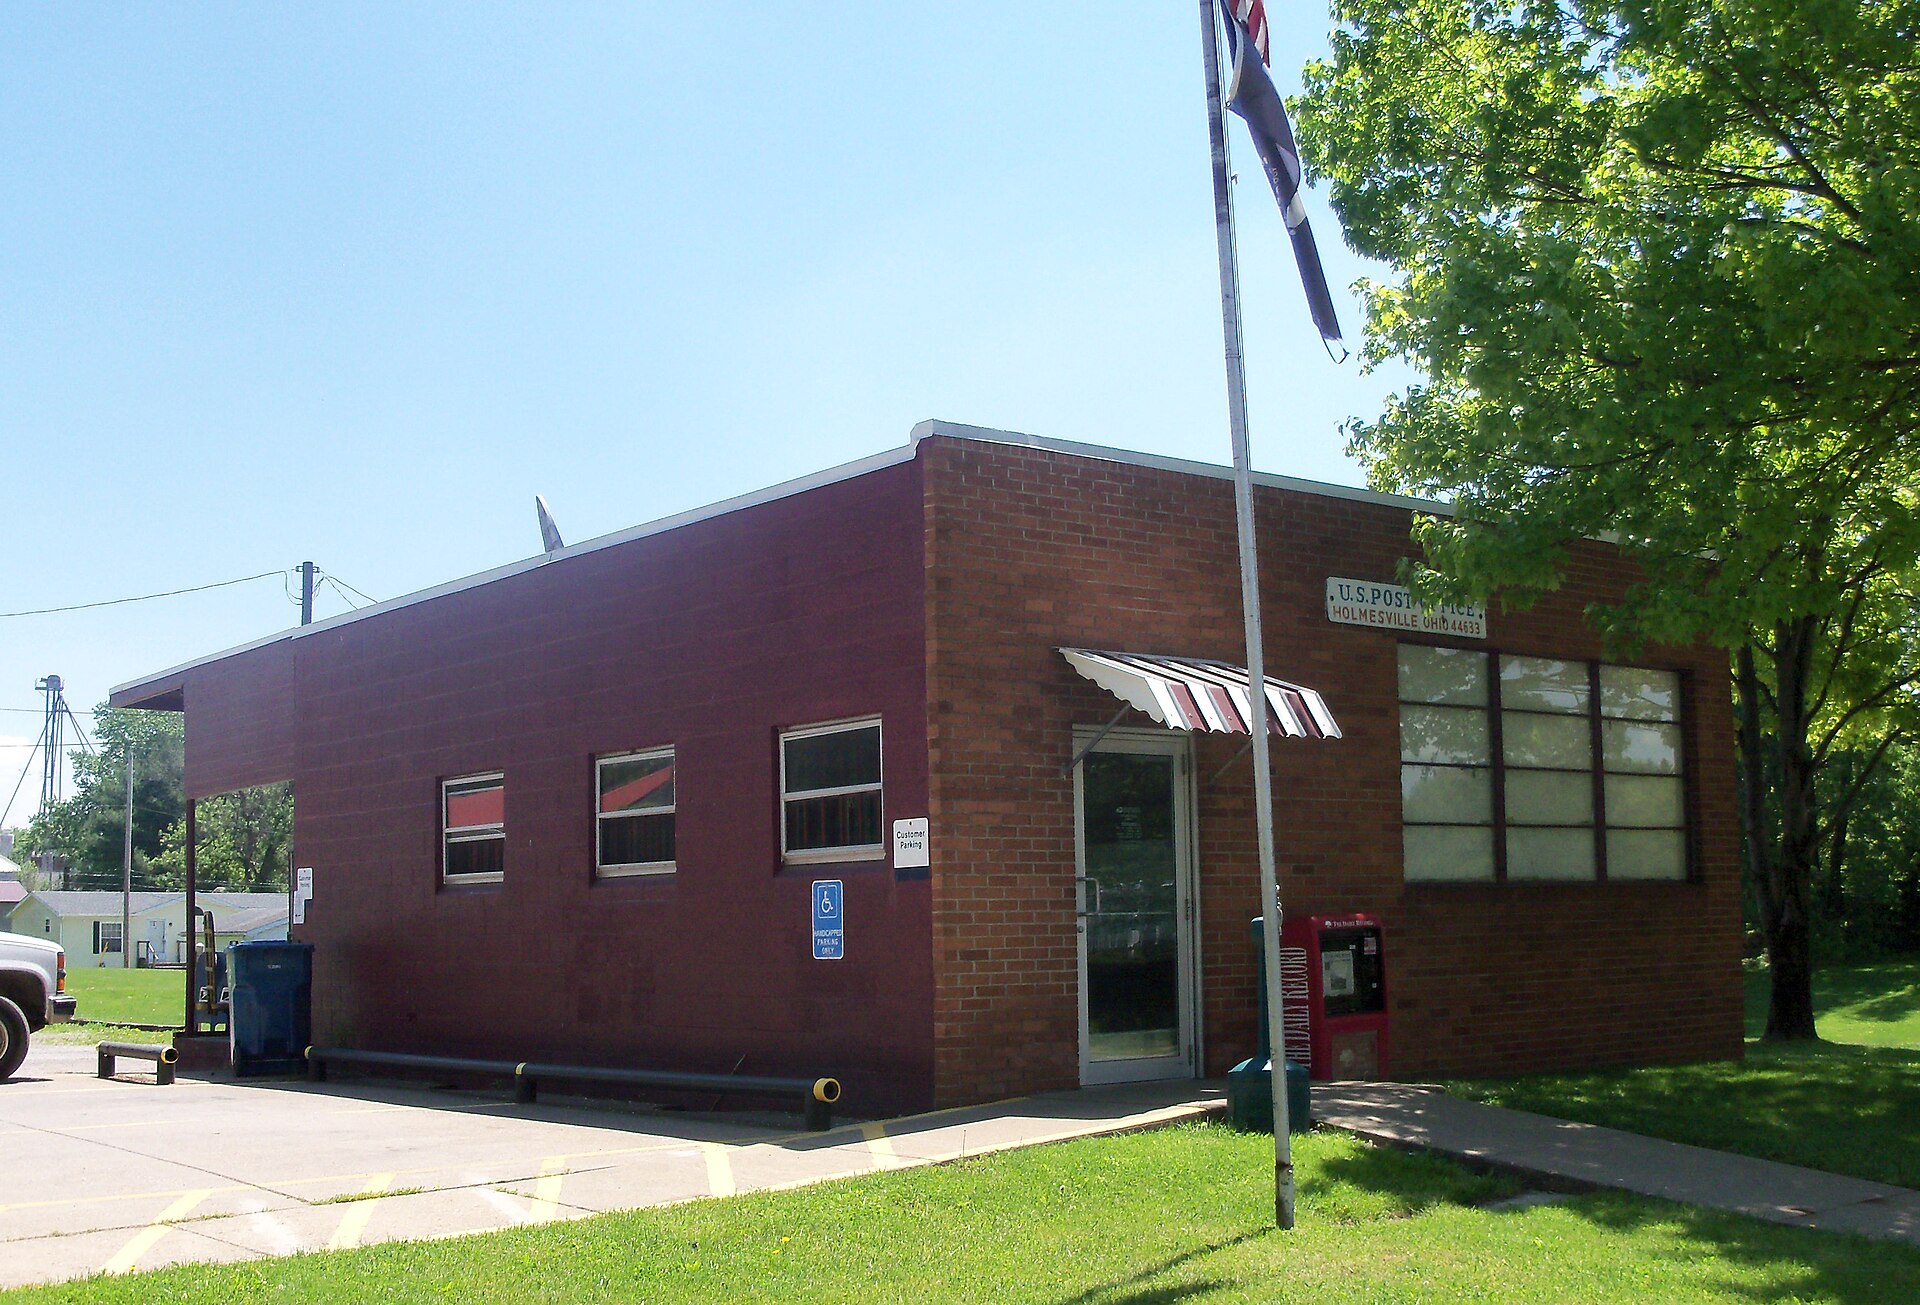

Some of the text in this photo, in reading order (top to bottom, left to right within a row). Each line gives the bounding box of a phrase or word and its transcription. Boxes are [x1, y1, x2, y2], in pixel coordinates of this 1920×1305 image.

[1332, 605, 1418, 627] HOLMESVILLE
[1451, 619, 1480, 635] 44633
[896, 831, 925, 839] Customer
[900, 840, 921, 850] Parking
[817, 938, 839, 946] PARKING
[1279, 947, 1309, 1000] RECORD
[1282, 1004, 1311, 1041] DAILY
